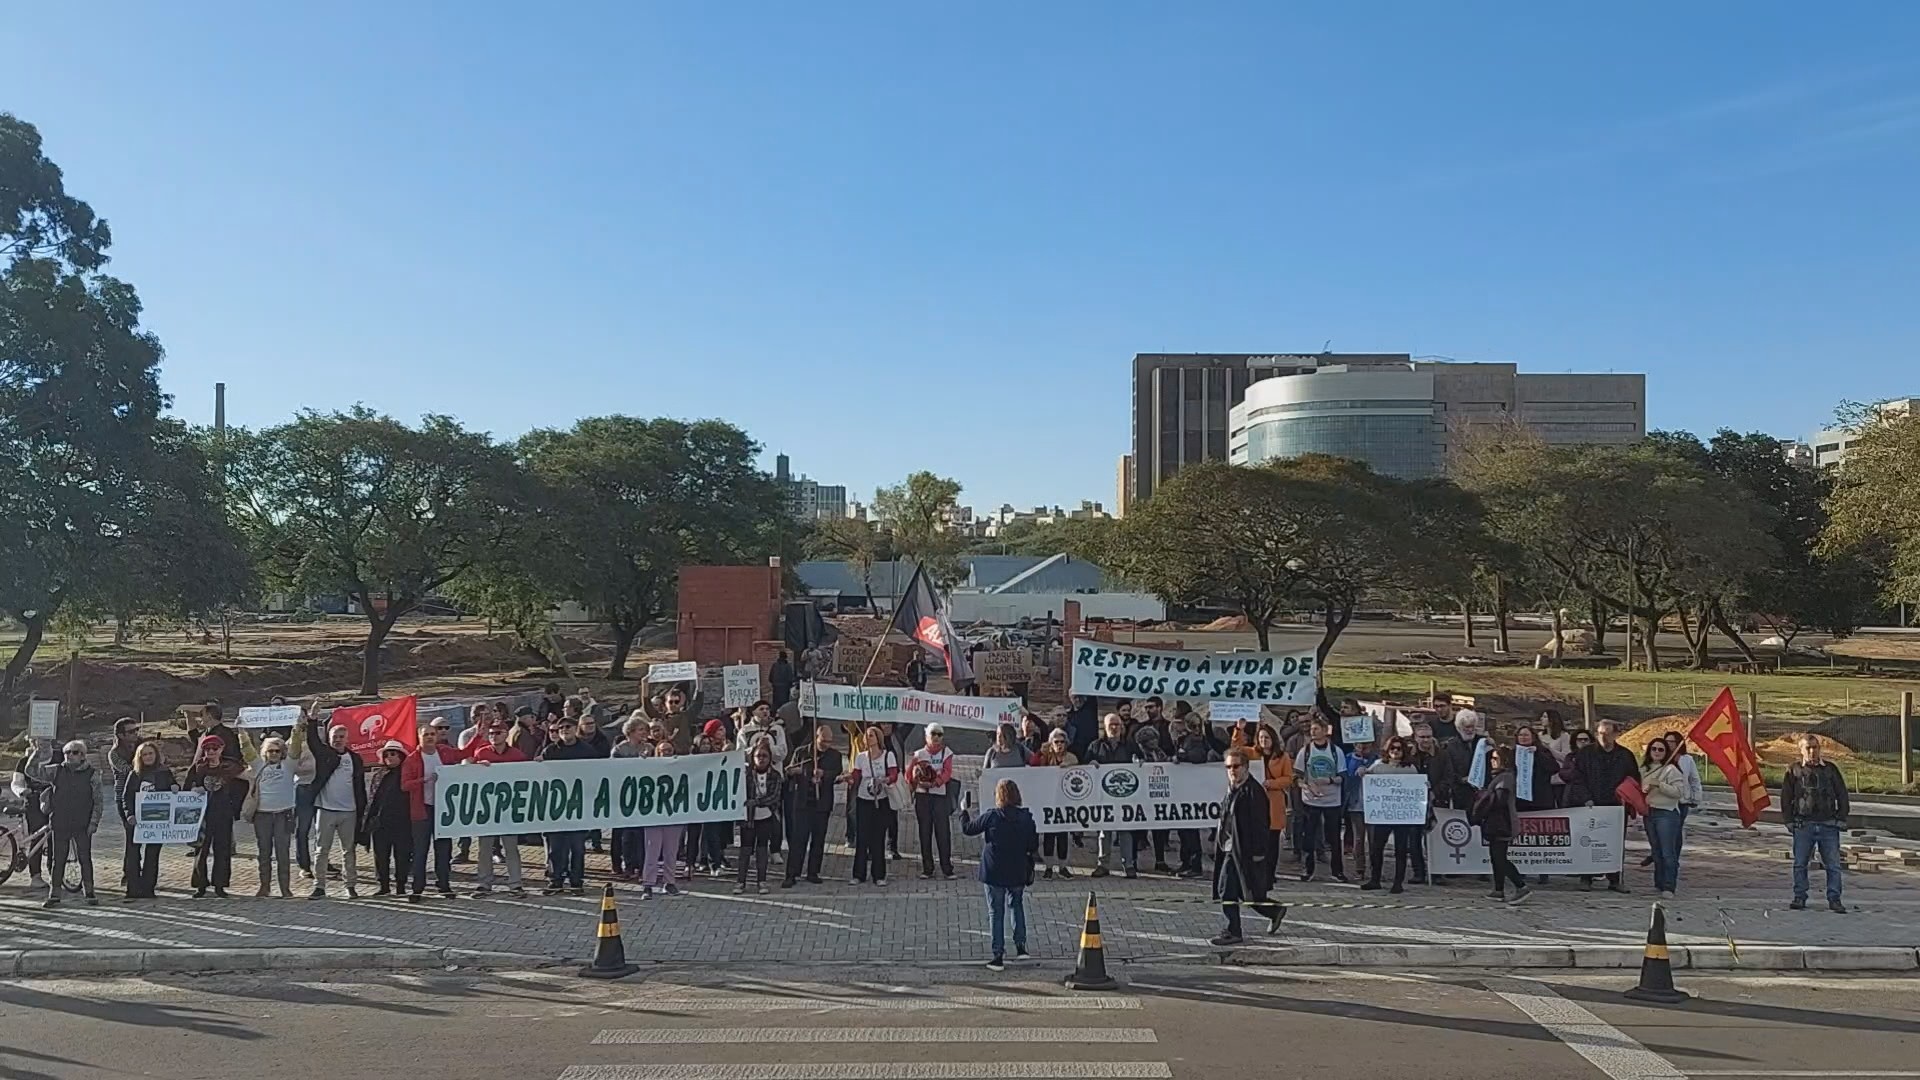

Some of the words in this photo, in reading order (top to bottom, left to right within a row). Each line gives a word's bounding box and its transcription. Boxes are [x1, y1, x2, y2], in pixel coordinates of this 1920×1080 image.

[1077, 647, 1190, 673] RESPEITO
[1197, 655, 1210, 674] À
[1220, 659, 1273, 675] VIDA
[1282, 657, 1313, 676] DE
[729, 688, 759, 699] PARQUE
[1094, 672, 1168, 695] TODOS
[1174, 679, 1205, 697] OS
[1209, 680, 1297, 700] SERES!
[833, 692, 840, 707] A
[844, 693, 898, 713] REDENÇÃO
[901, 694, 920, 712] NÃO
[924, 699, 945, 715] TEM
[948, 703, 985, 719] PREÇO!
[440, 778, 583, 826] SUSPENDA
[594, 777, 610, 819] A
[620, 773, 689, 818] OBRA
[697, 757, 741, 813] JÁ!
[1370, 778, 1402, 788] NOSSOS
[144, 793, 171, 801] ANTES
[1043, 804, 1115, 828] PARQUE
[1122, 804, 1147, 822] DA
[1154, 802, 1222, 821] HARMO
[1519, 818, 1569, 833] ESTRAL
[1512, 834, 1538, 846] ALÉM
[1539, 835, 1550, 846] DE
[1553, 835, 1570, 846] 250
